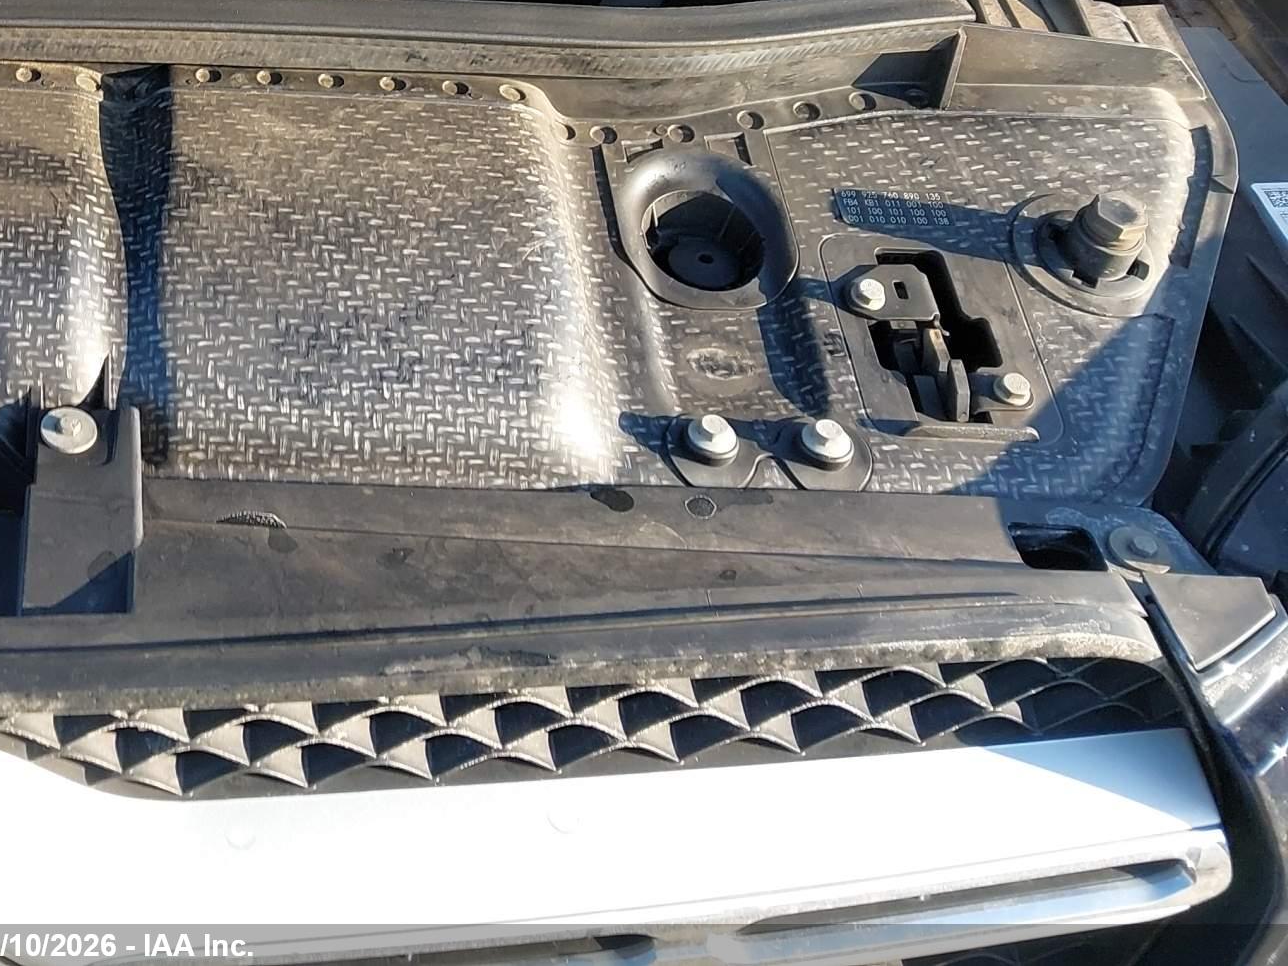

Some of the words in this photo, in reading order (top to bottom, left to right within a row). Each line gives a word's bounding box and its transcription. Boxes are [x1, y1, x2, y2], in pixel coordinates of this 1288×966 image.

[906, 200, 922, 208] 001
[927, 201, 944, 209] 100
[867, 207, 883, 215] 100
[888, 208, 903, 216] 101
[909, 208, 925, 217] 100
[930, 209, 946, 218] 100
[847, 214, 864, 223] 001
[869, 215, 886, 224] 010
[890, 216, 907, 224] 010
[912, 217, 928, 225] 100
